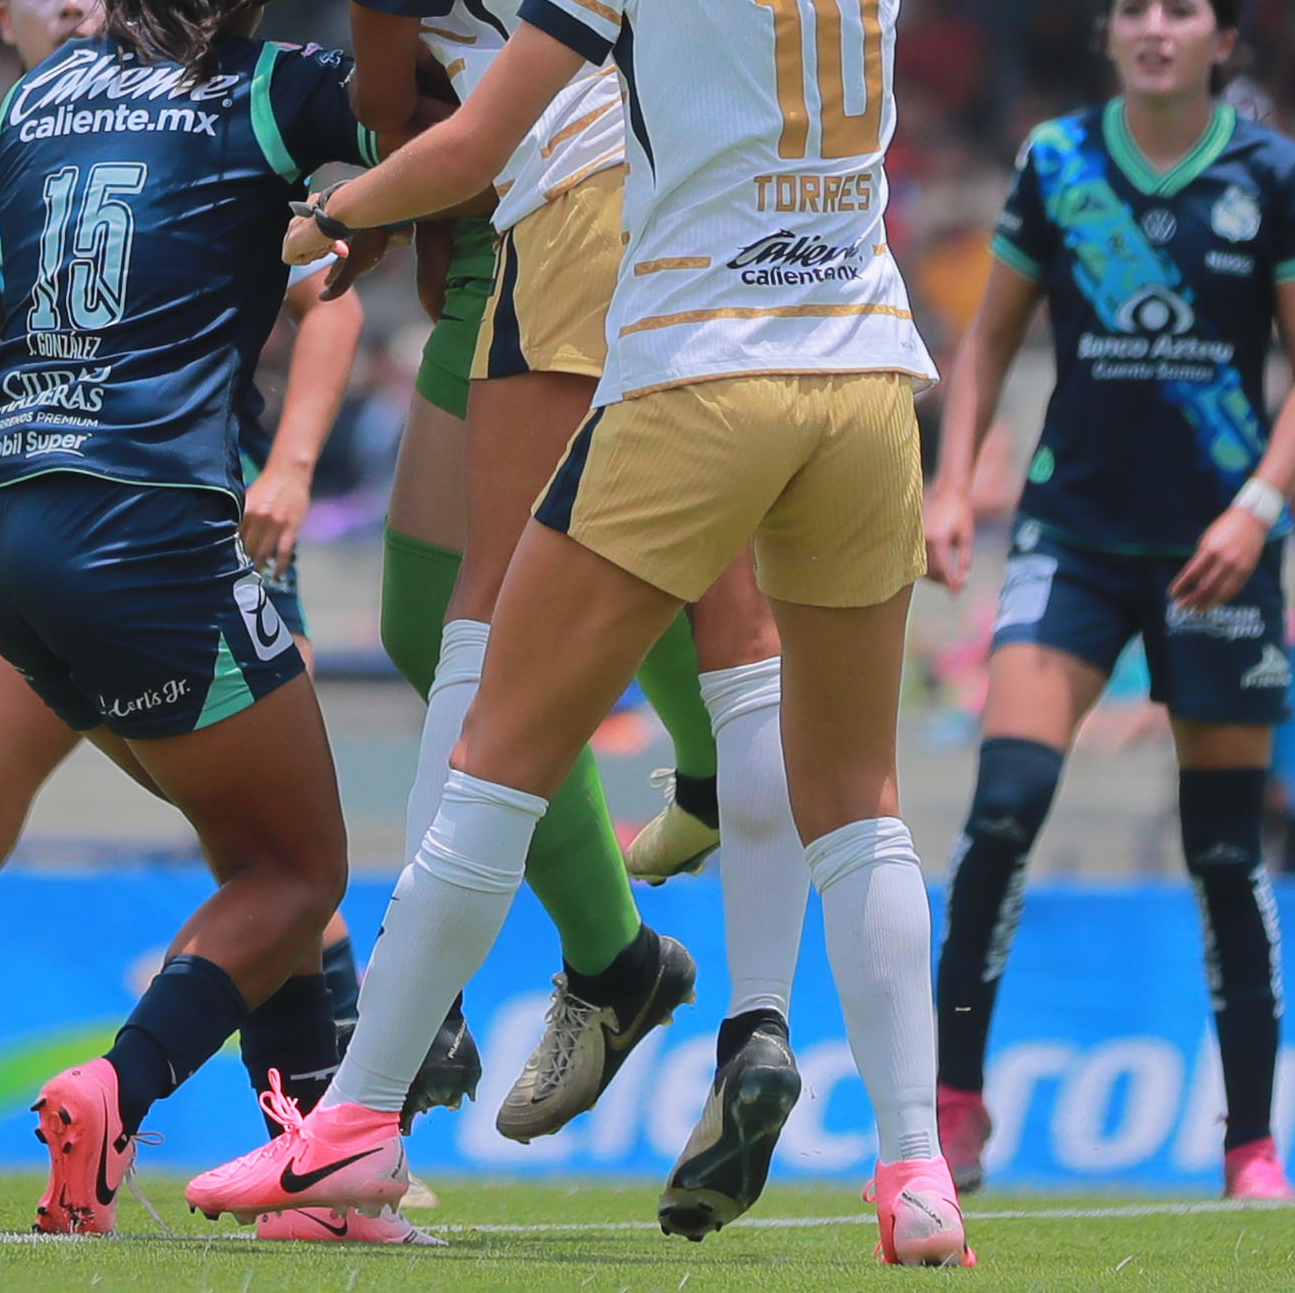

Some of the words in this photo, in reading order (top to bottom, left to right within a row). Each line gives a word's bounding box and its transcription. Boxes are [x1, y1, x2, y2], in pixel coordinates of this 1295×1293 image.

[19, 103, 219, 143] caliente.mx
[754, 173, 872, 213] TORRES
[26, 162, 148, 334] 15
[37, 331, 102, 360] GONZÁLEZ
[36, 411, 99, 428] PREMIUM
[162, 678, 191, 704] Jr.
